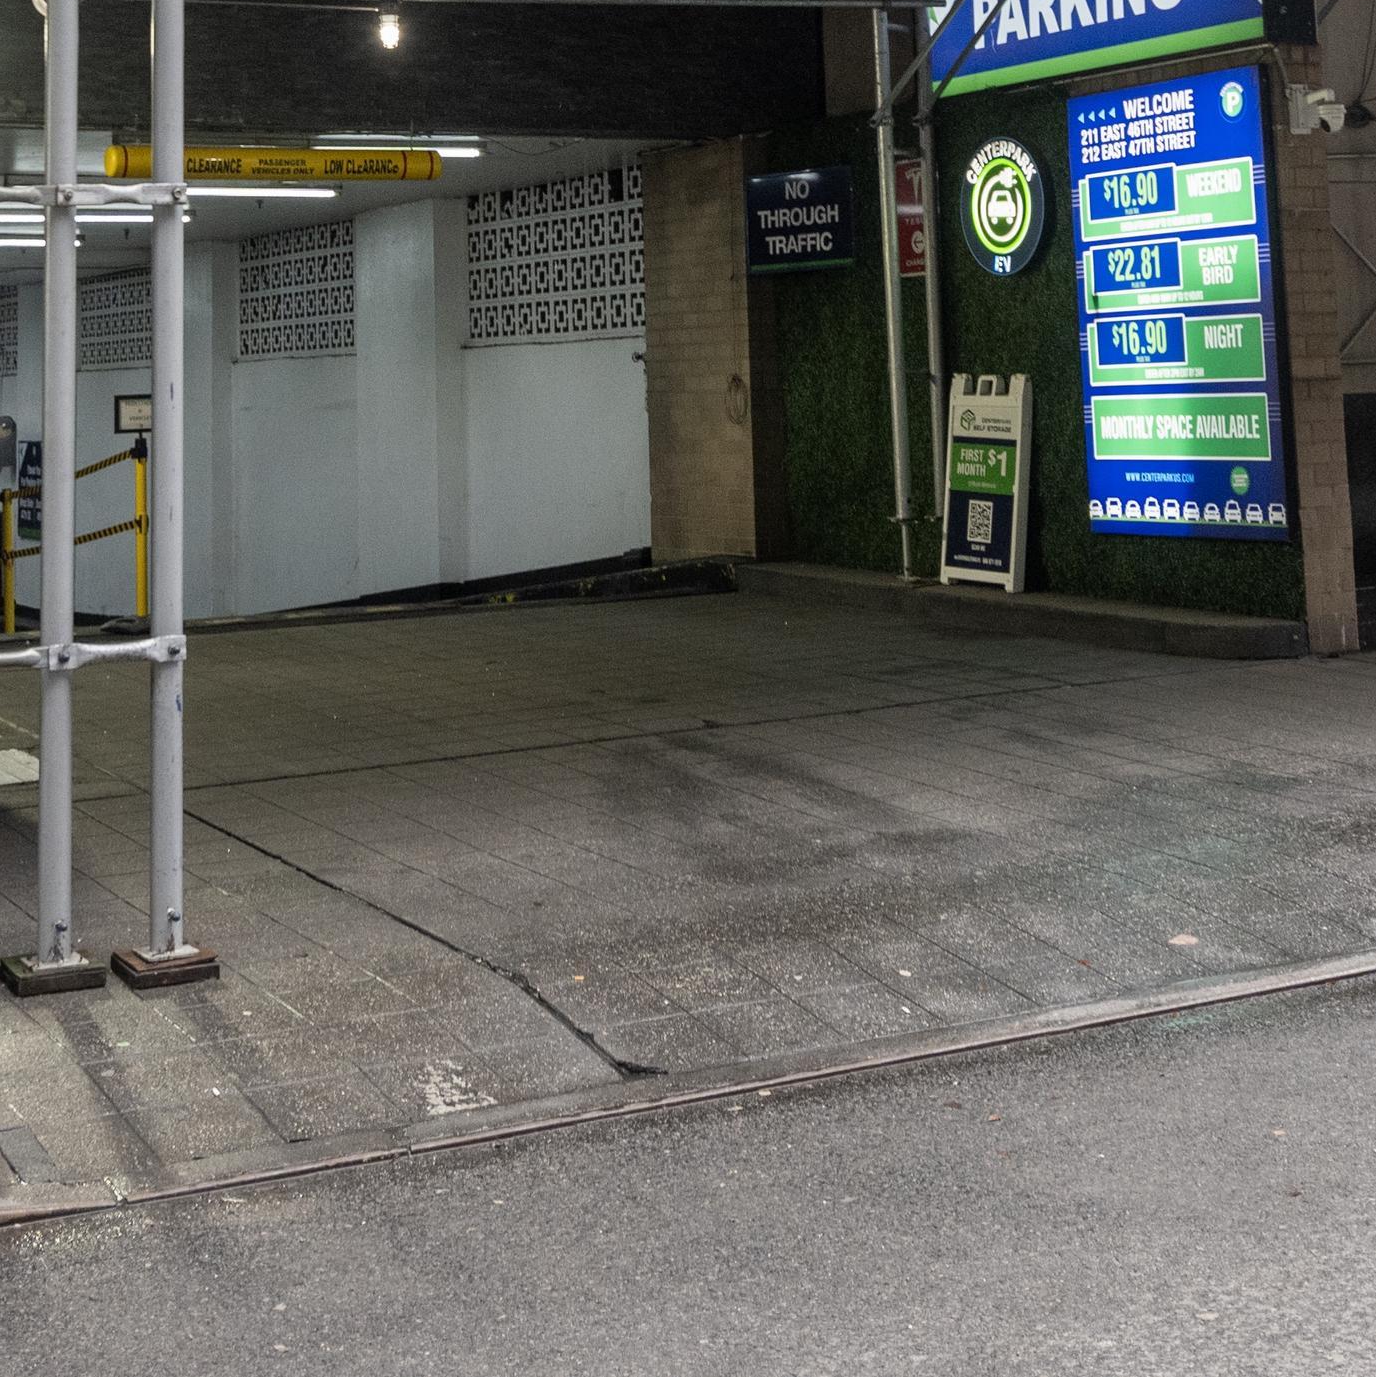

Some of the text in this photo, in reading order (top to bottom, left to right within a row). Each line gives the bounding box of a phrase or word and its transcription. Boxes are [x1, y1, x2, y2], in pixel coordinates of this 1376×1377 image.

[1123, 89, 1194, 119] WELCOME
[1080, 112, 1195, 146] 211 EAST 46TH STREET
[1081, 130, 1196, 164] 212 EAST 47TH STREET
[186, 159, 243, 174] CLEARANCE
[258, 159, 307, 167] PASSENGER
[324, 159, 343, 174] LOW
[966, 140, 1036, 184] CENTERPARK
[784, 180, 809, 200] NO
[1103, 171, 1158, 208] $16.90
[1185, 167, 1242, 198] WEEKEND
[757, 204, 839, 229] THROUGH
[765, 232, 833, 255] TRAFFIC
[1198, 244, 1239, 267] EARLY
[994, 255, 1012, 273] EV
[1107, 245, 1161, 282] $22.81
[1202, 265, 1234, 286] BIRD
[1112, 320, 1167, 355] $16.90
[1204, 324, 1243, 349] NIGHT
[1100, 415, 1260, 439] MONTHLY SPACE AVAILABLE
[960, 448, 984, 462] FIRST
[987, 448, 1007, 477] $1
[957, 462, 986, 477] MONTH
